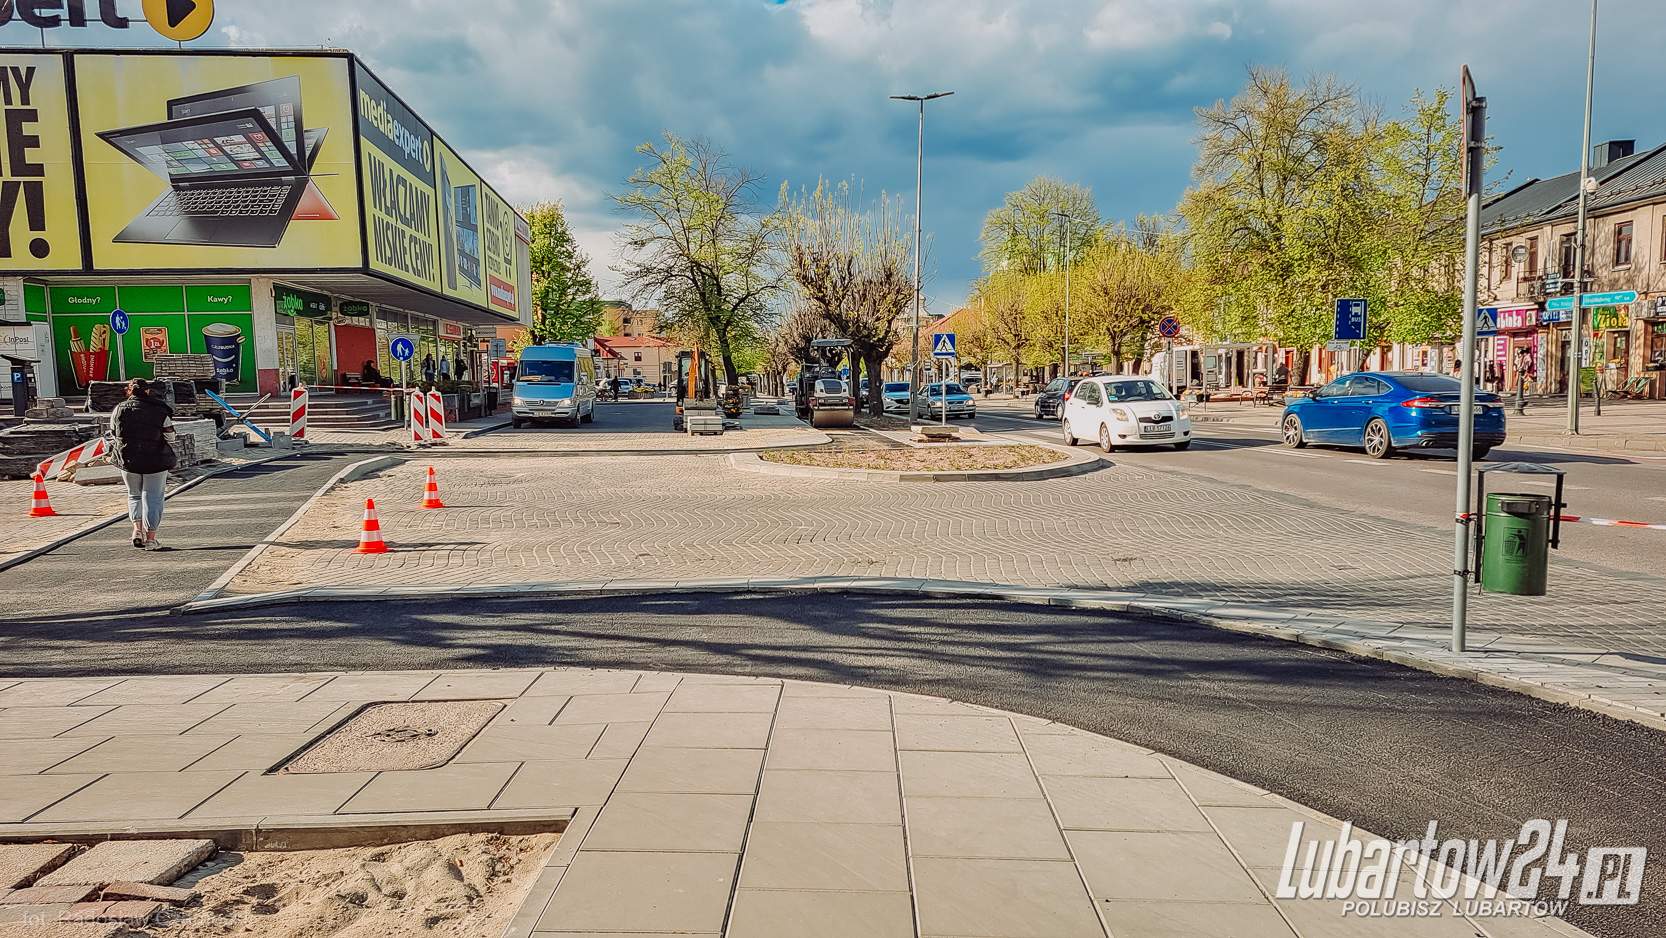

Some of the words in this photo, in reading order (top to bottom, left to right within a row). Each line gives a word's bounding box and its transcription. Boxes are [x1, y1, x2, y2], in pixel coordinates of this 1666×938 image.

[0, 0, 129, 29] ert
[360, 88, 423, 165] mediaexpert
[367, 151, 431, 238] WŁĄCZAMY
[372, 214, 408, 272] NISKIE
[408, 233, 436, 283] CENY!
[207, 295, 233, 304] Kawy?
[13, 372, 21, 380] P
